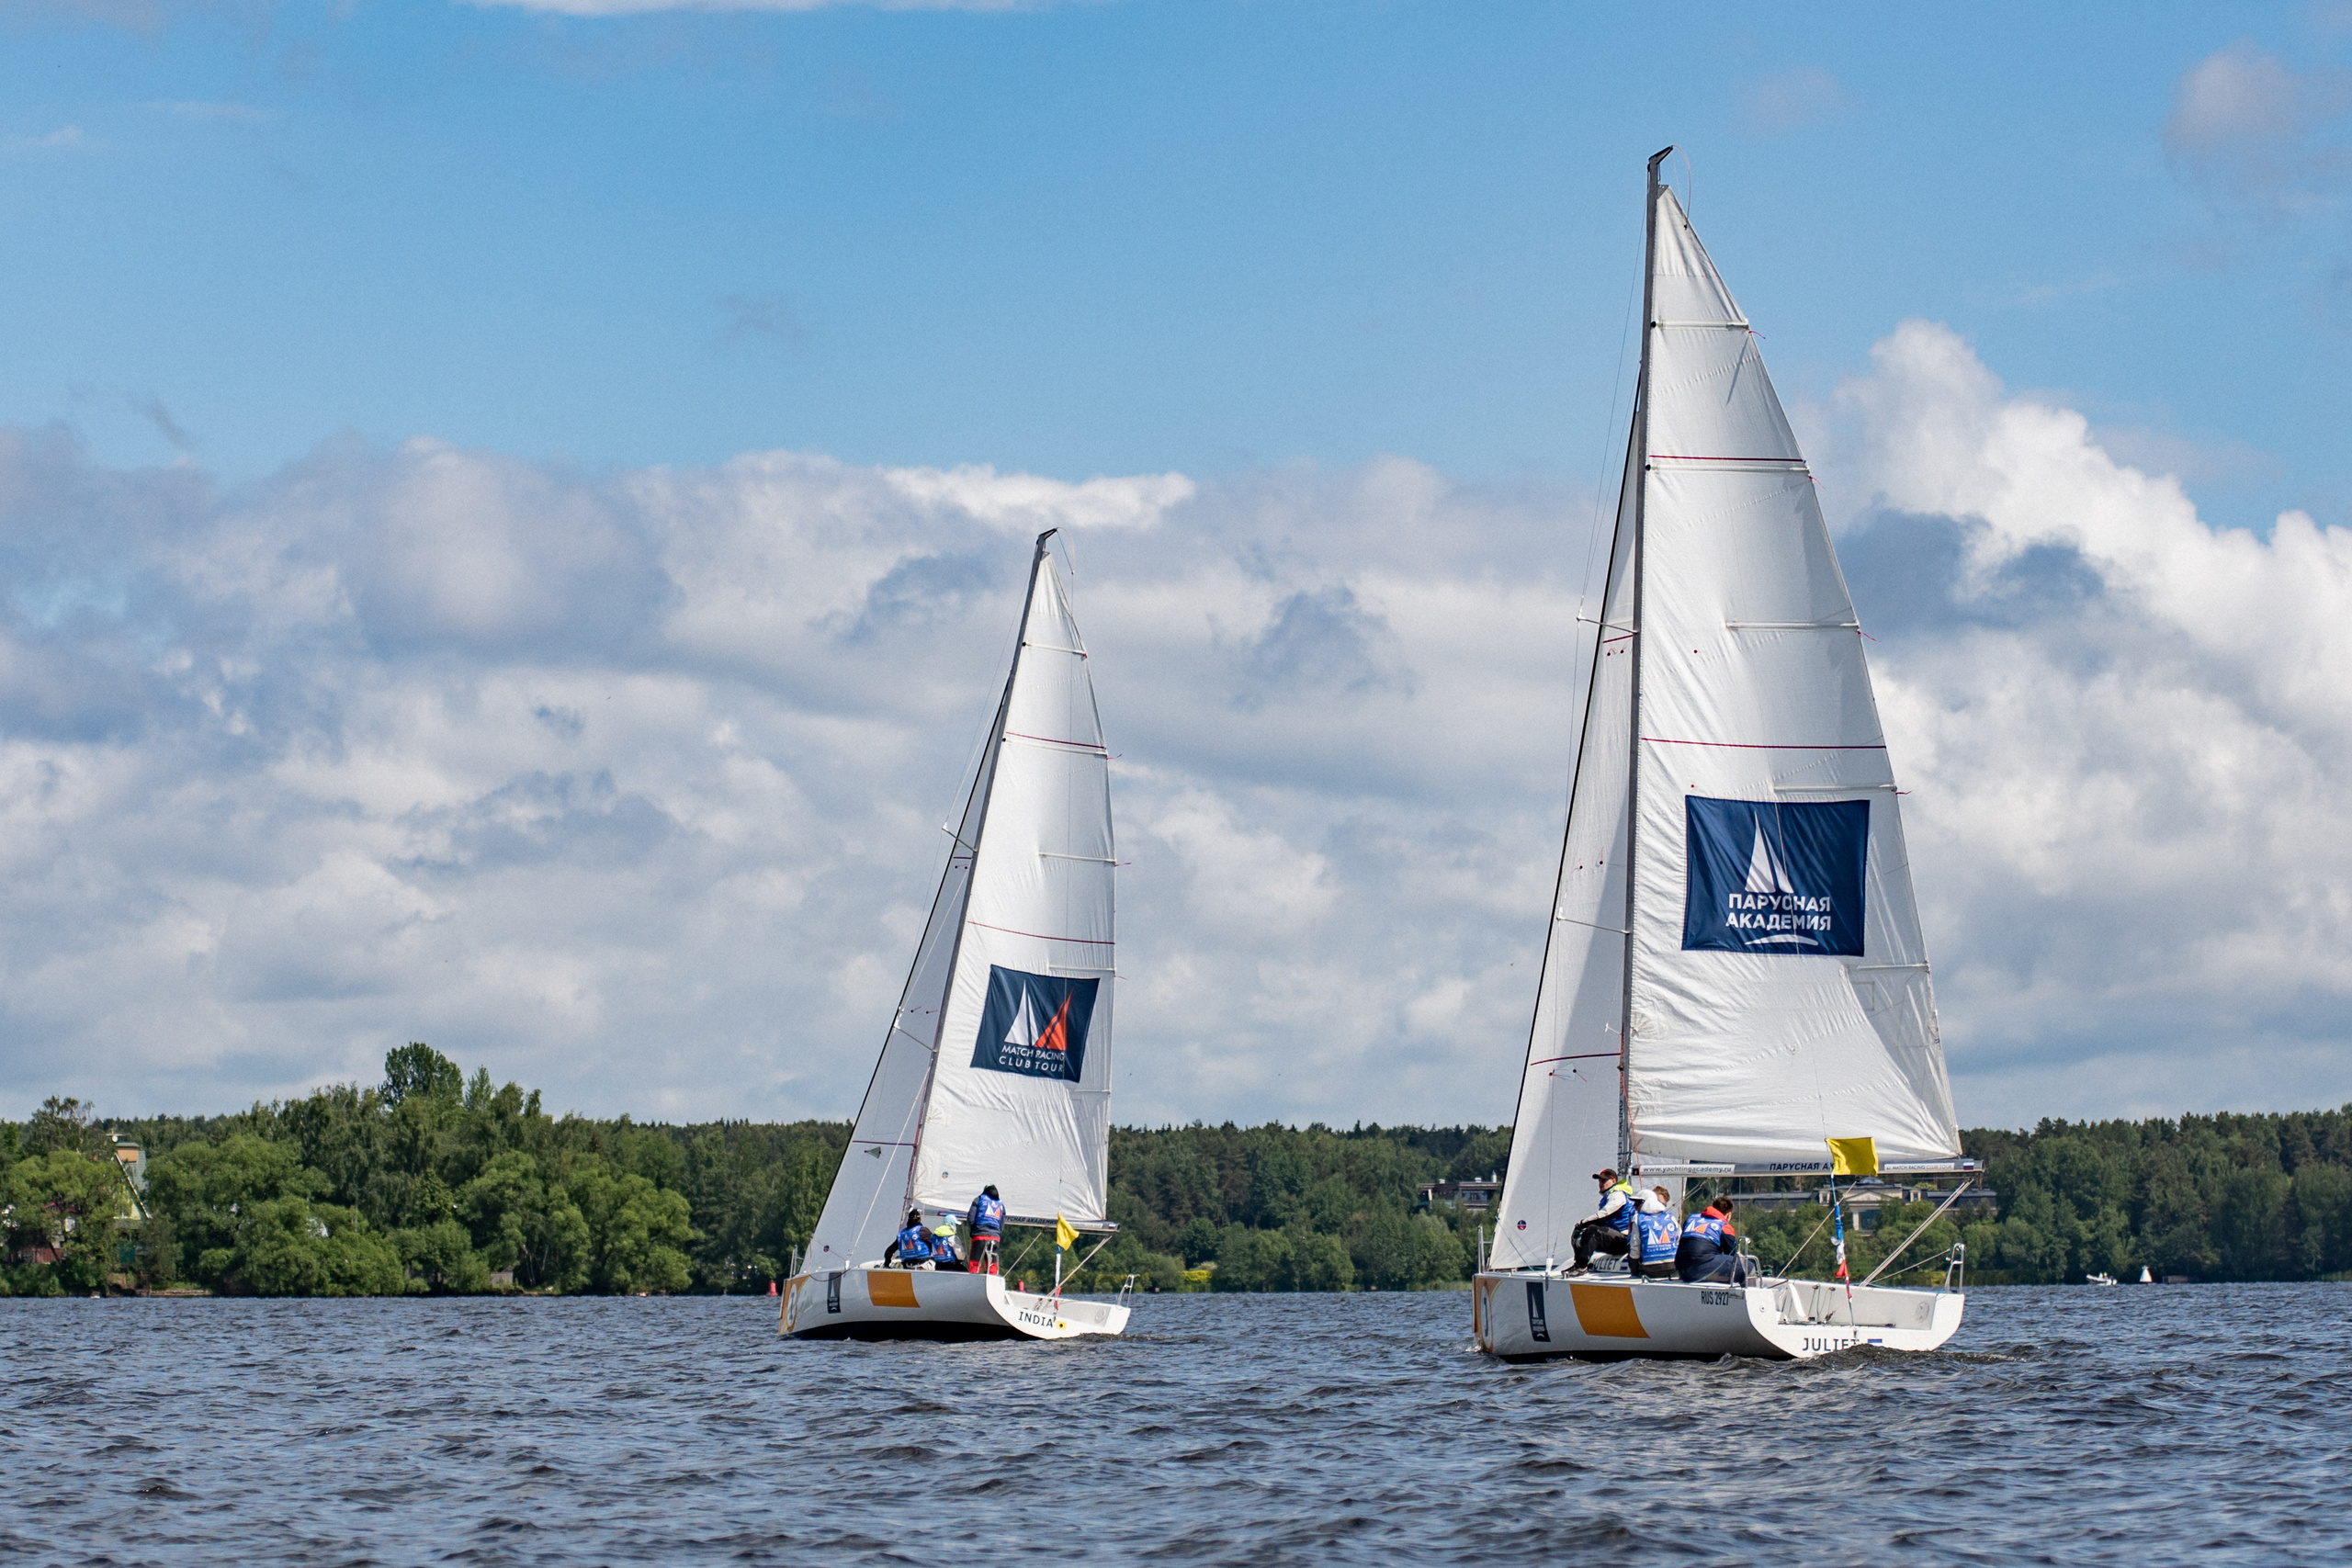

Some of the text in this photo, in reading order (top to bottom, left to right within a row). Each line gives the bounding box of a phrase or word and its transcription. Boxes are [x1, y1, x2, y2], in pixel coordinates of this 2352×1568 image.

[1728, 893, 1831, 912] ПАРУСНАЯ
[1725, 912, 1831, 931] АКАДЕМИЯ
[1001, 1044, 1065, 1061] MATCH RACING
[999, 1055, 1064, 1073] CLUB TOUR
[1643, 1165, 1732, 1174] www.yachtingacademy.ru
[1770, 1162, 1820, 1171] ПАРУСНАЯ
[1701, 1291, 1729, 1306] RUS 2927
[1018, 1311, 1054, 1328] INDIA
